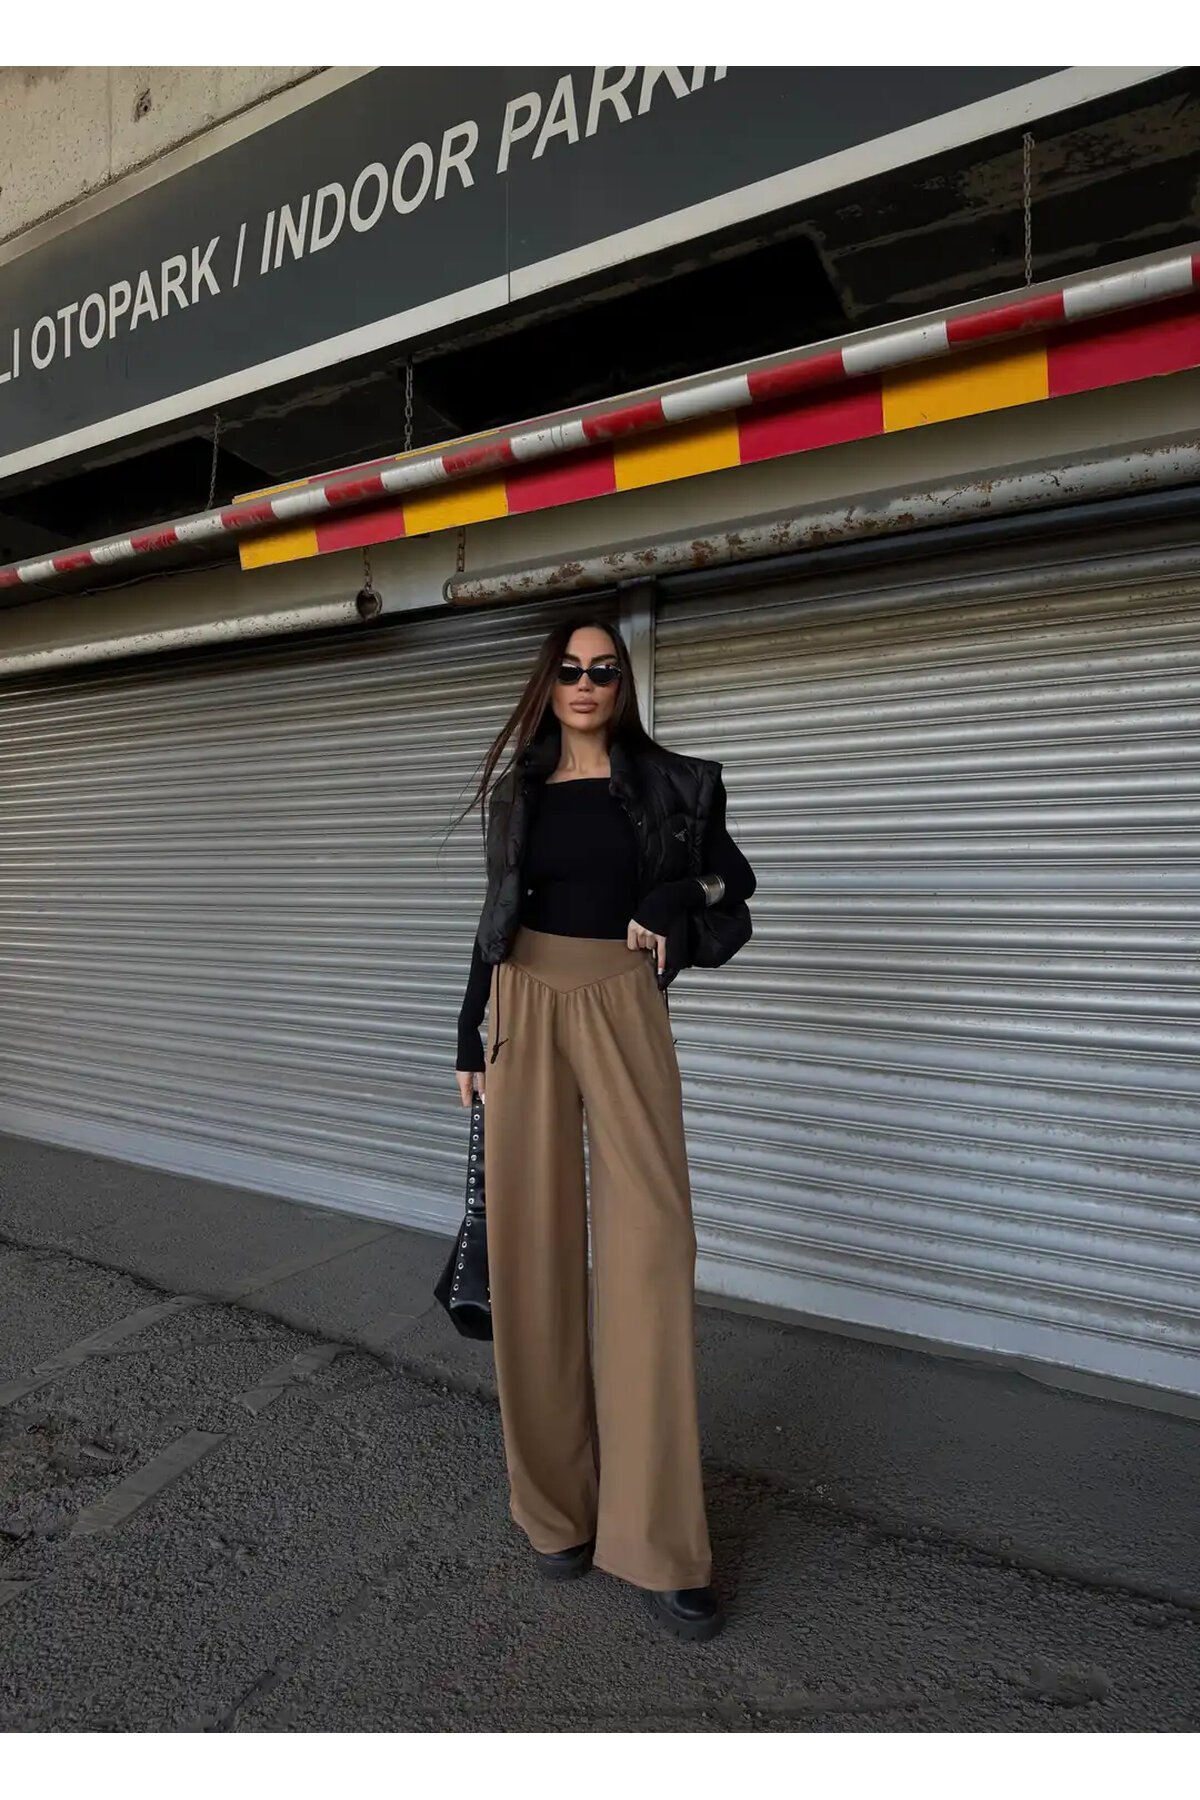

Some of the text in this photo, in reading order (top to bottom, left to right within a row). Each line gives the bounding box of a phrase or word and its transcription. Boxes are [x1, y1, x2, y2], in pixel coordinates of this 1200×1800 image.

[31, 236, 220, 369] OTOPARK
[233, 223, 246, 287] /
[260, 121, 478, 275] INDOOR
[497, 66, 727, 174] PARK
